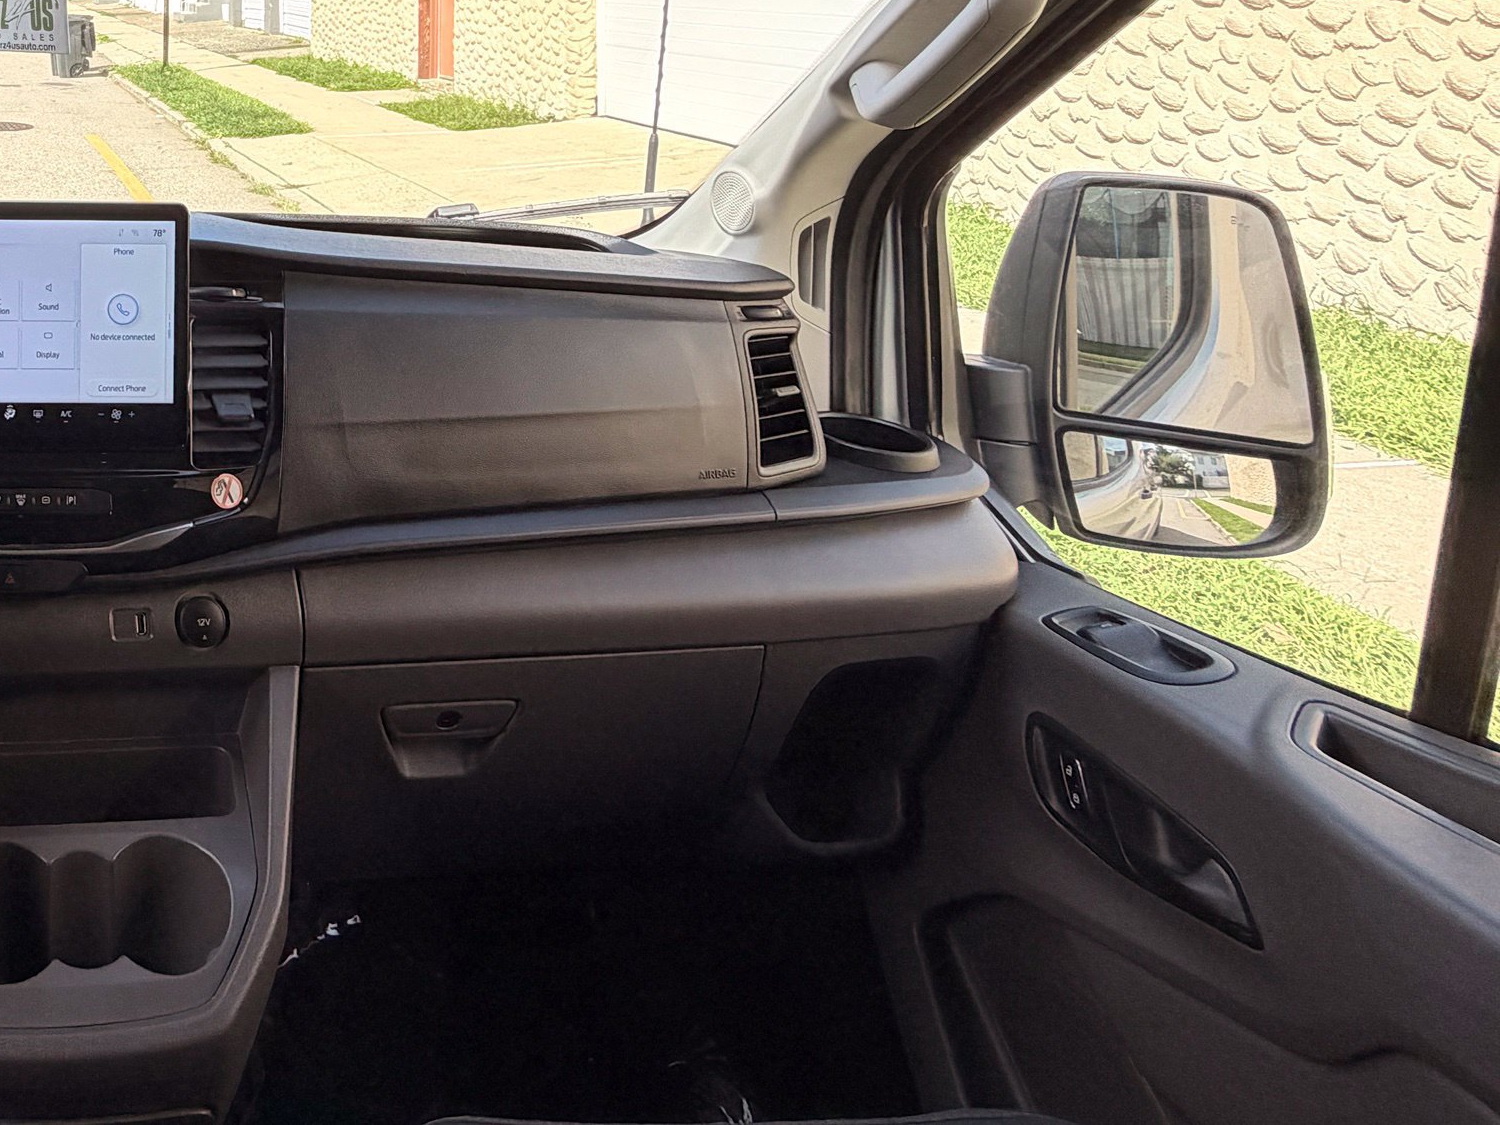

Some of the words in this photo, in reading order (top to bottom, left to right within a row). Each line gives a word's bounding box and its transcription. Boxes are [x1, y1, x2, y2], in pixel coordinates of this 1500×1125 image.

[13, 32, 54, 42] SALES
[113, 247, 135, 255] Phone
[38, 302, 59, 311] Sound
[90, 333, 100, 341] No
[100, 333, 121, 341] device
[121, 333, 156, 341] connected
[36, 351, 60, 360] Display
[125, 384, 147, 392] Phone
[60, 410, 73, 418] A/C
[699, 468, 736, 479] AIRBAG
[197, 618, 211, 627] 12V
